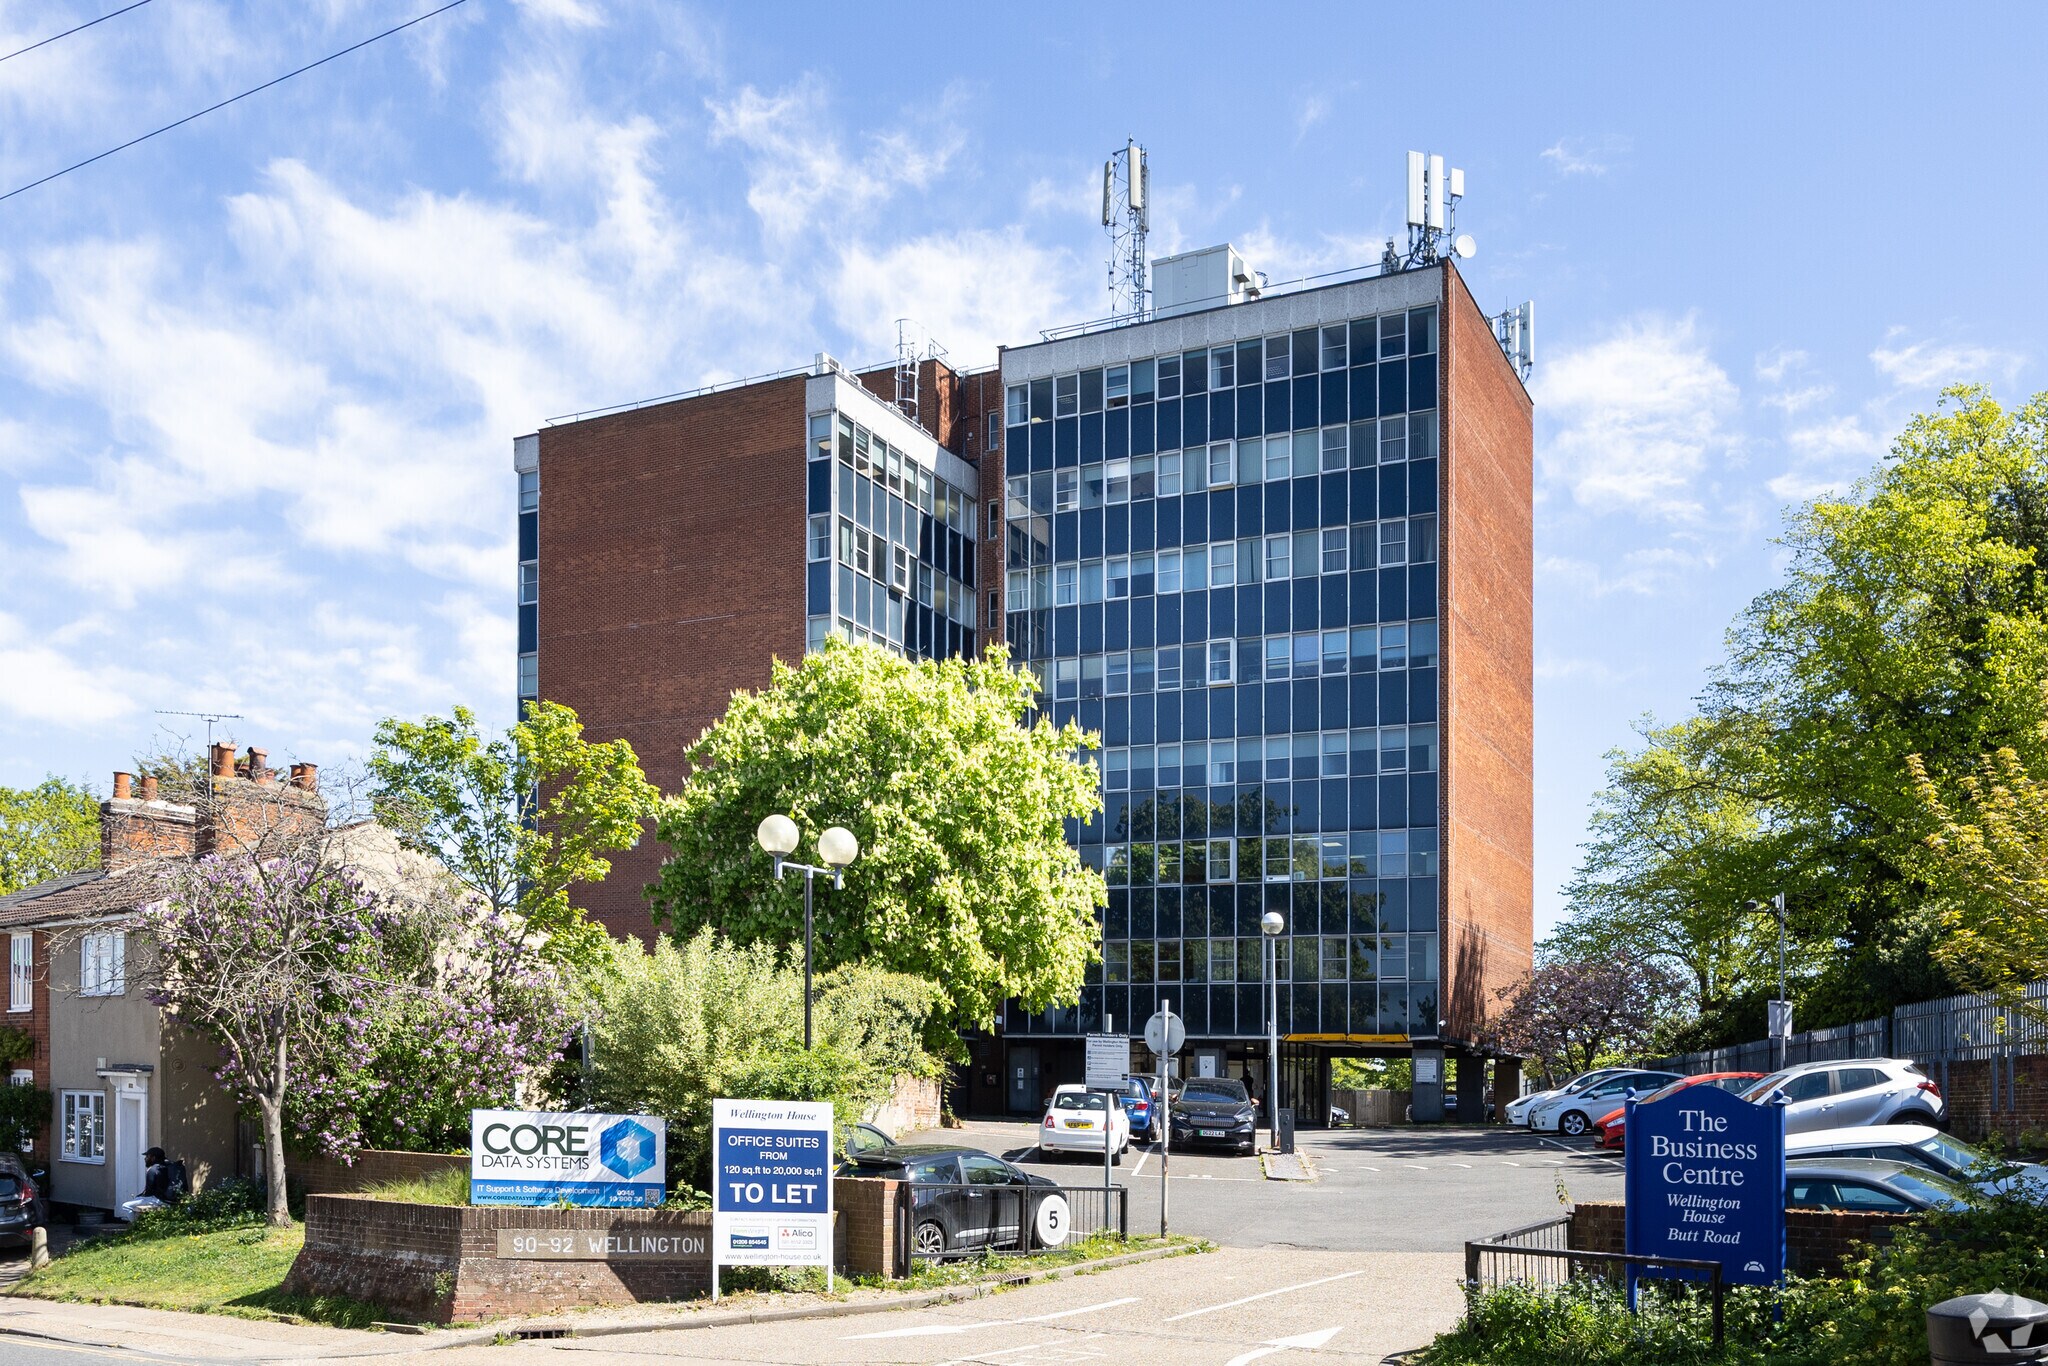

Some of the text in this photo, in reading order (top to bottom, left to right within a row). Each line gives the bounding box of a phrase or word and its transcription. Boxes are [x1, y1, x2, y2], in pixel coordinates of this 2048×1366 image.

[731, 1109, 816, 1120] Wellington House
[1678, 1110, 1727, 1132] The
[482, 1123, 589, 1156] CORE
[728, 1136, 819, 1148] OFFICE SUITES
[1650, 1136, 1757, 1160] Business
[482, 1155, 589, 1170] DATA SYSTEMS
[760, 1152, 787, 1160] FROM
[725, 1166, 740, 1174] 120
[742, 1166, 761, 1176] sq.ft
[773, 1167, 802, 1176] 20,000
[804, 1168, 822, 1177] sq.ft
[1663, 1162, 1744, 1186] Centre
[486, 1185, 514, 1193] Support
[555, 1186, 600, 1195] Development
[730, 1183, 818, 1204] TO LET
[1667, 1194, 1741, 1210] Wellington
[1049, 1210, 1058, 1229] 5
[1682, 1209, 1725, 1224] House
[1668, 1227, 1741, 1245] Butt Road
[512, 1236, 705, 1254] 90-92 WELLINGTON
